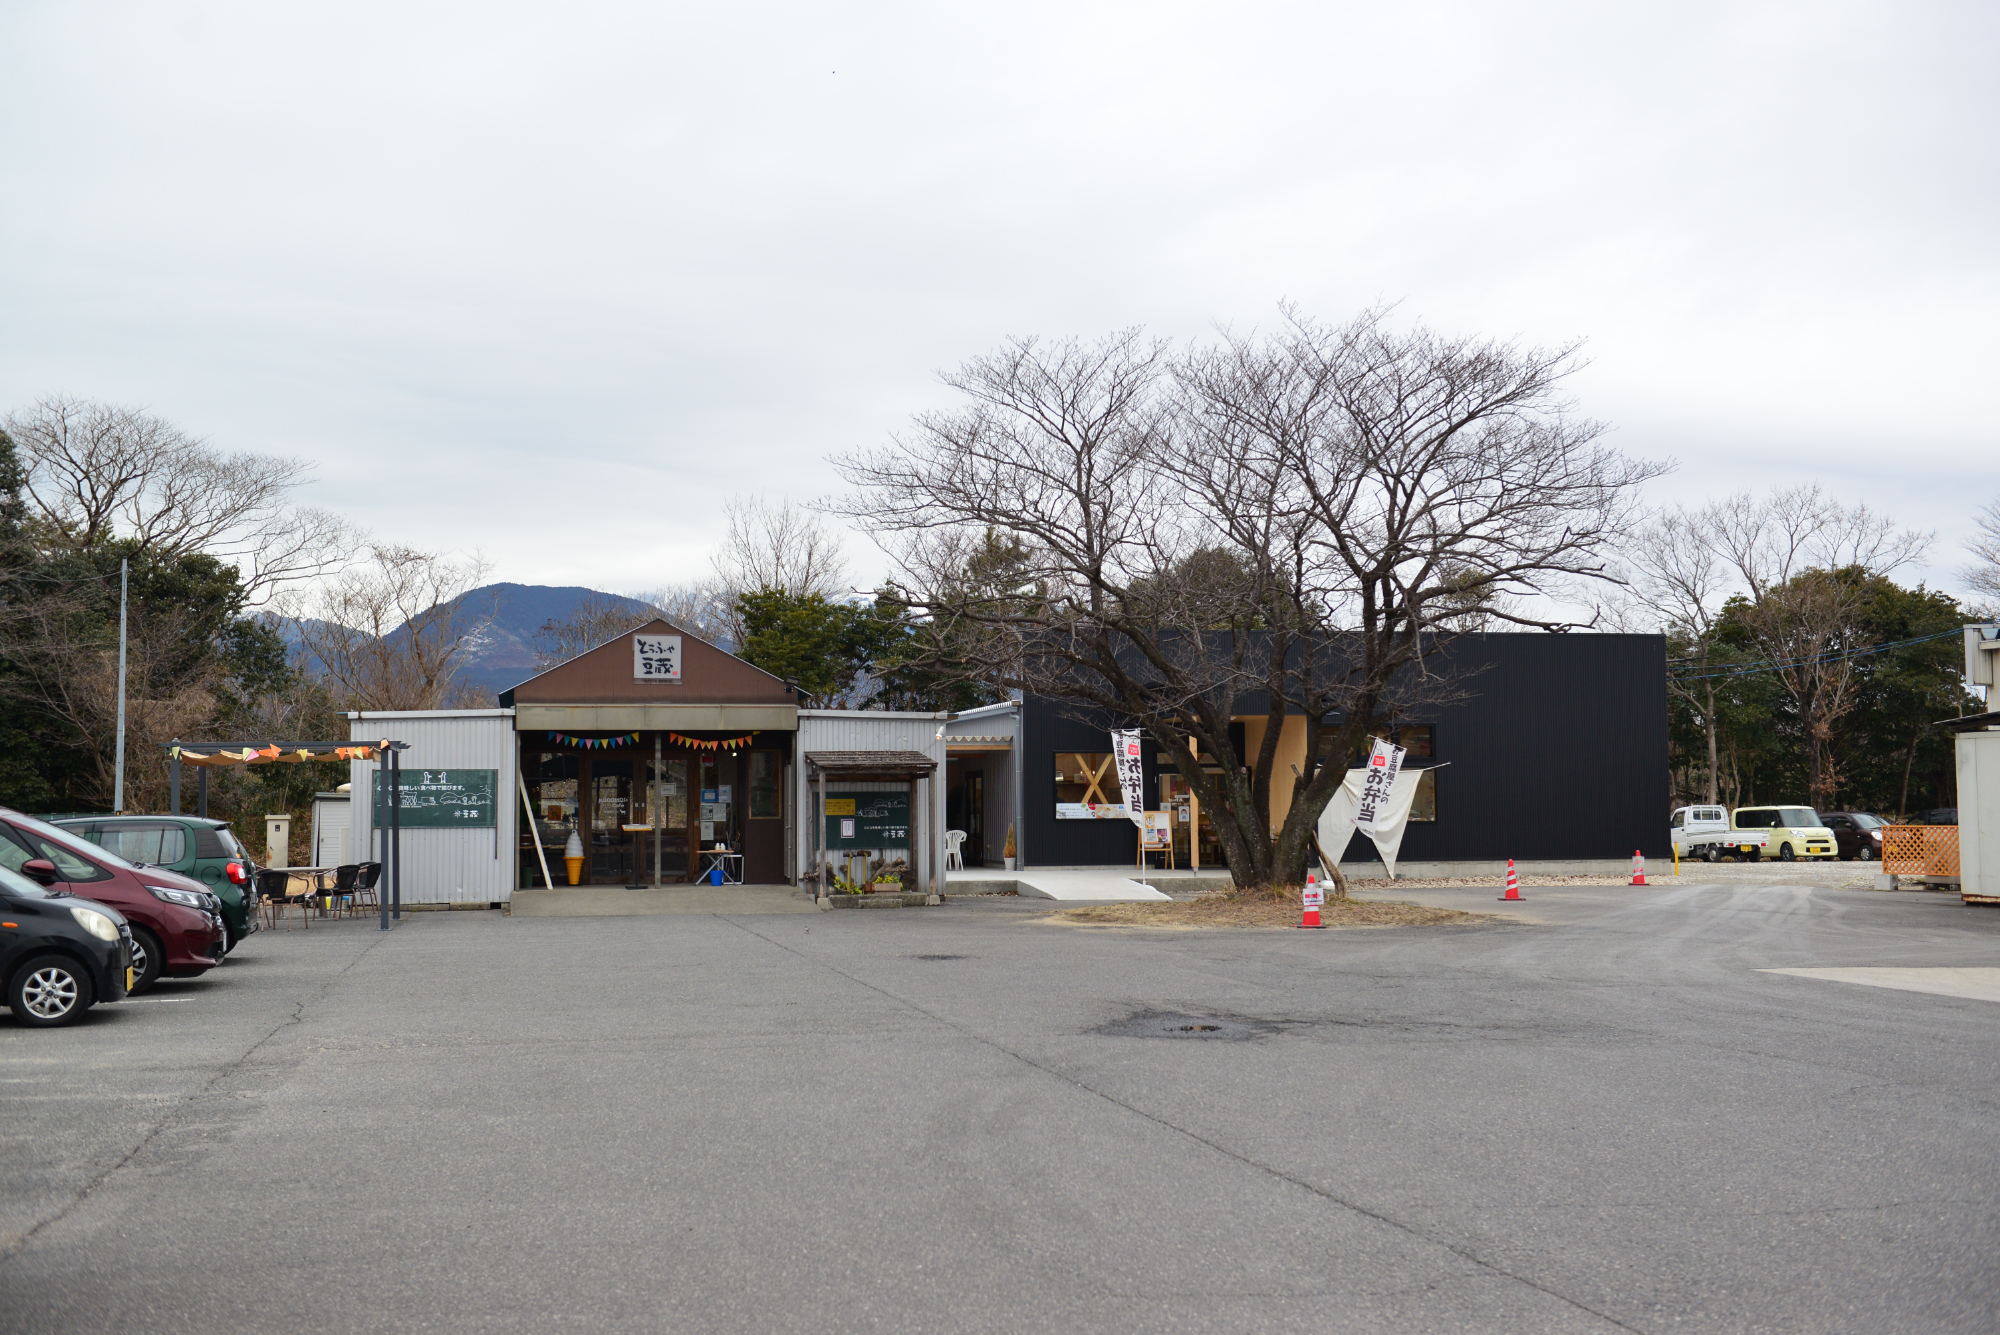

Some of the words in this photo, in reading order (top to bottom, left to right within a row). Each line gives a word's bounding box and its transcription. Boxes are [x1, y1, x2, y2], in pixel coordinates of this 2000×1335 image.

[637, 638, 675, 654] とうふや
[642, 657, 674, 675] 豆蔵
[1380, 745, 1399, 804] お豆腐屋さんの
[1357, 767, 1387, 823] お弁当
